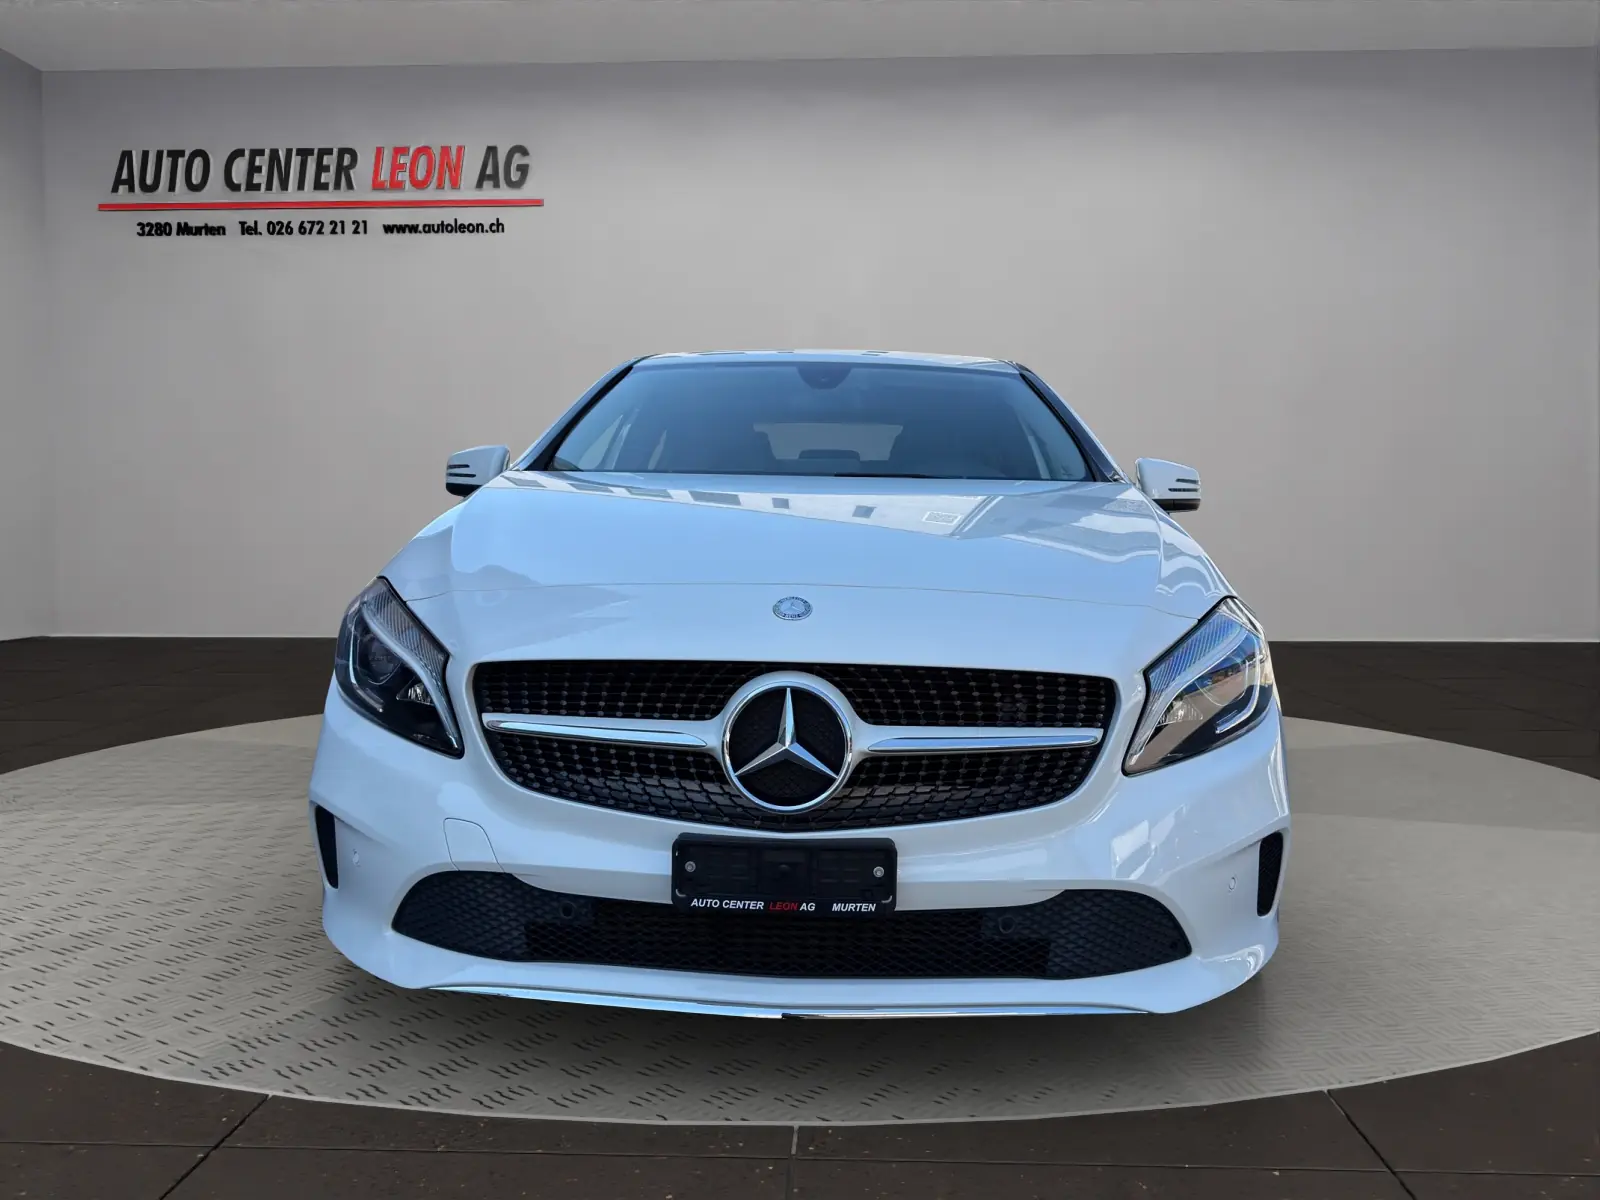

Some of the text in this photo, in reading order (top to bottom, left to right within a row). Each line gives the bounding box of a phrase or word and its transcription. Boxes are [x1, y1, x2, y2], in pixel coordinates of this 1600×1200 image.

[111, 144, 530, 193] AUTO CENTER LEON AG
[136, 218, 505, 237] 3280 Murten Tel. 026 672 21 21 www.autoleon.ch
[690, 898, 876, 912] AUTO CENTER LEON AG MURTEN
